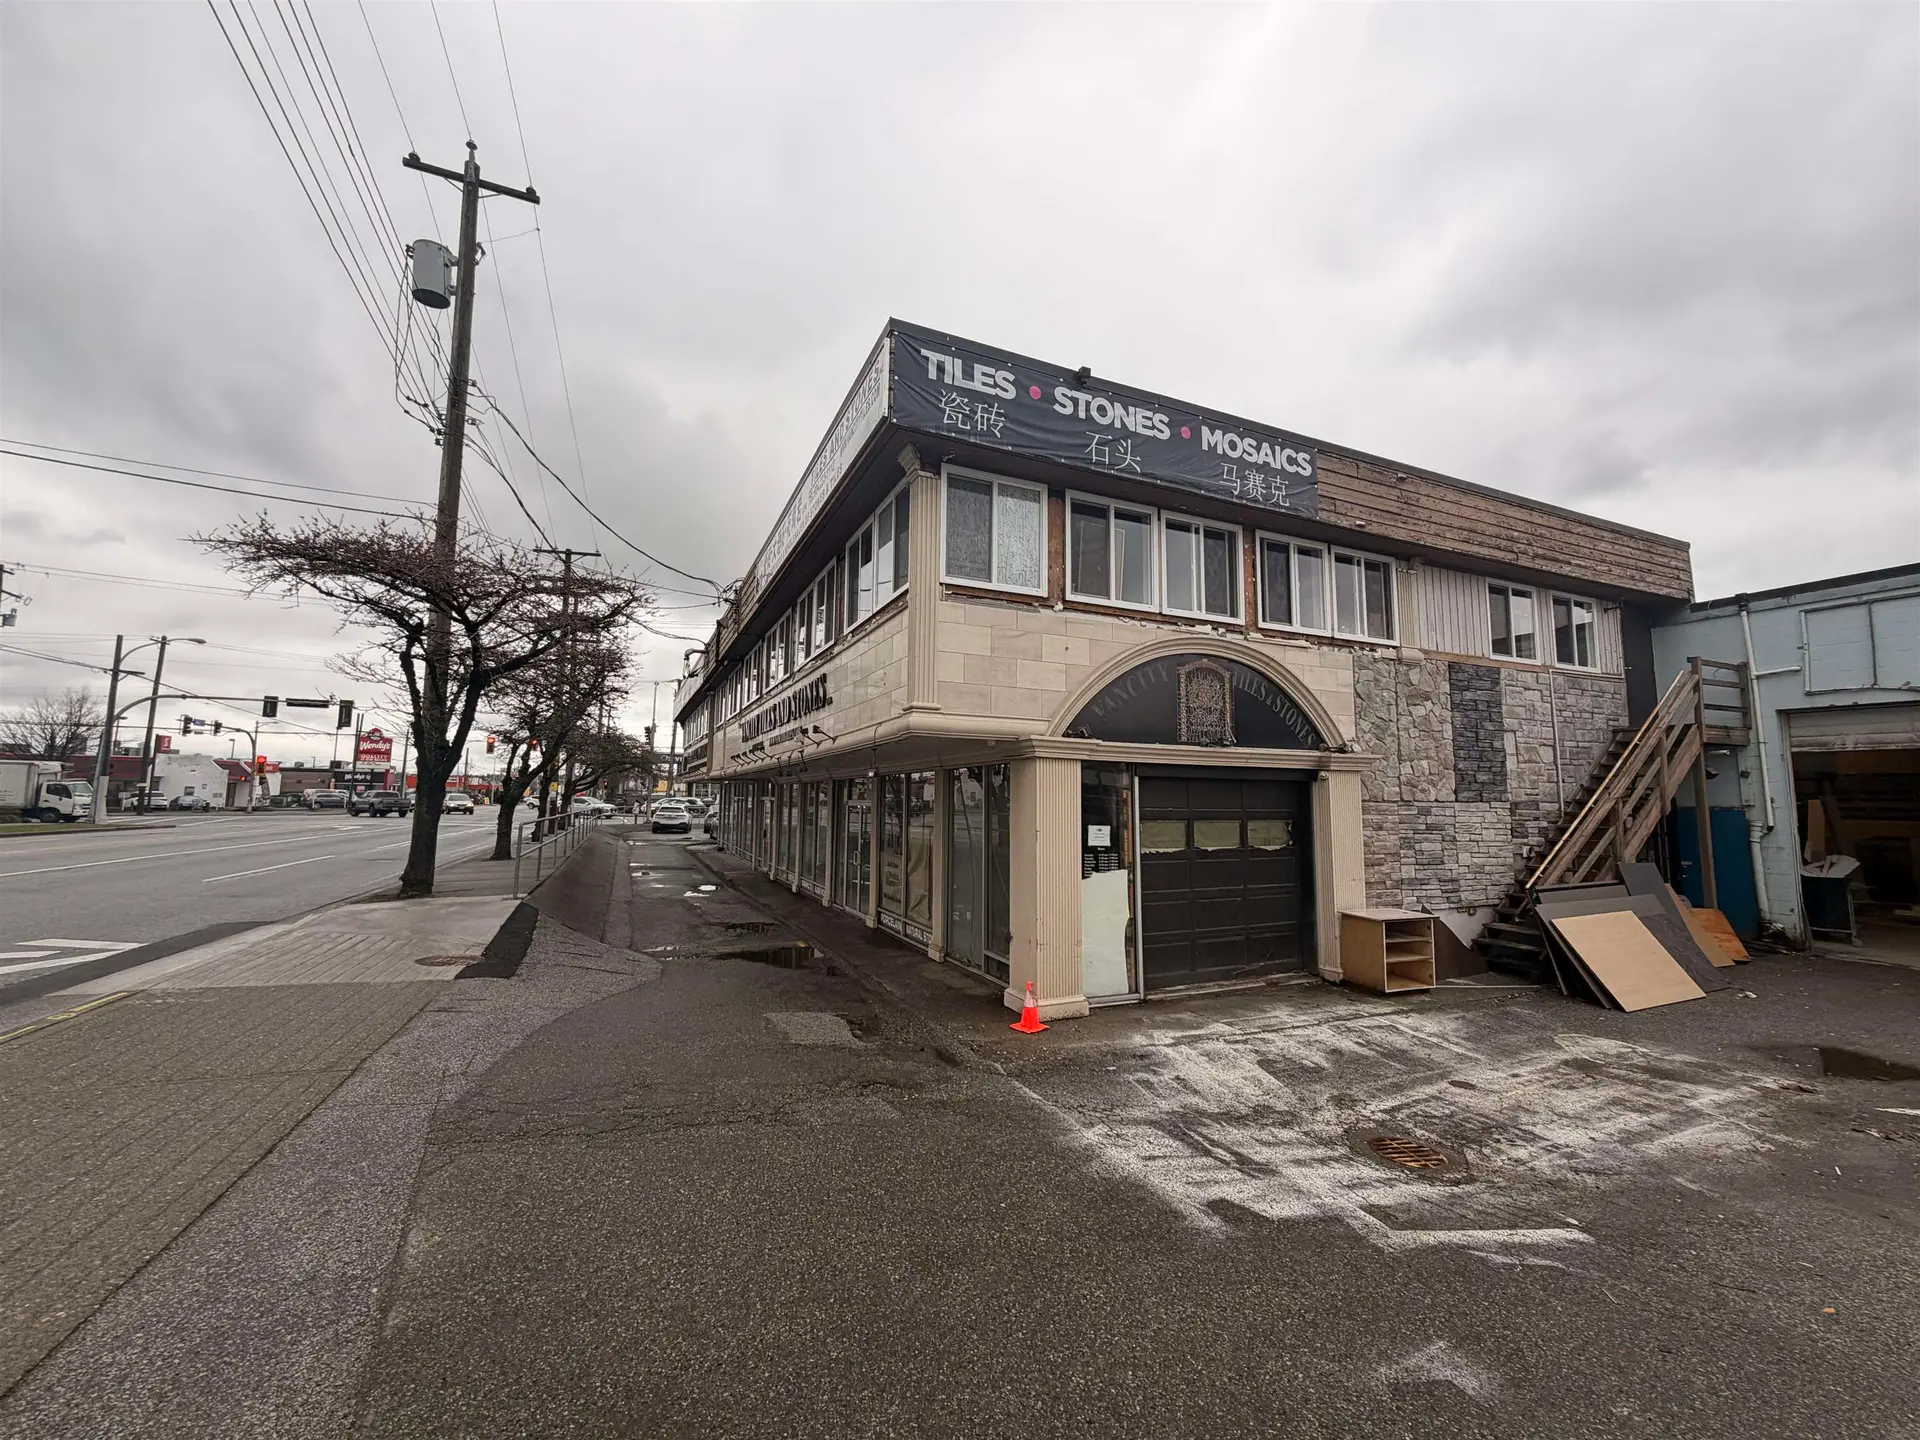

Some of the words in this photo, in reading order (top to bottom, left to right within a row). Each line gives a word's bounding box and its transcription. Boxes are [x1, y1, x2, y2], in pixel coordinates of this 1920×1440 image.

[829, 421, 845, 459] AND
[845, 359, 881, 430] STONES
[921, 349, 1016, 400] TILES
[1053, 386, 1171, 440] STONES
[1201, 425, 1312, 477] MOSAICS
[938, 388, 1006, 439] 瓷砖
[1084, 431, 1141, 474] 石头
[1219, 462, 1289, 508] 马赛克
[1093, 662, 1169, 721] VANCITY
[1232, 668, 1267, 702] TILES
[1265, 693, 1275, 706] &
[1272, 693, 1316, 749] STONES
[359, 740, 391, 751] Wendy's
[880, 913, 902, 931] PORCELAIN
[906, 923, 923, 941] NATURAL
